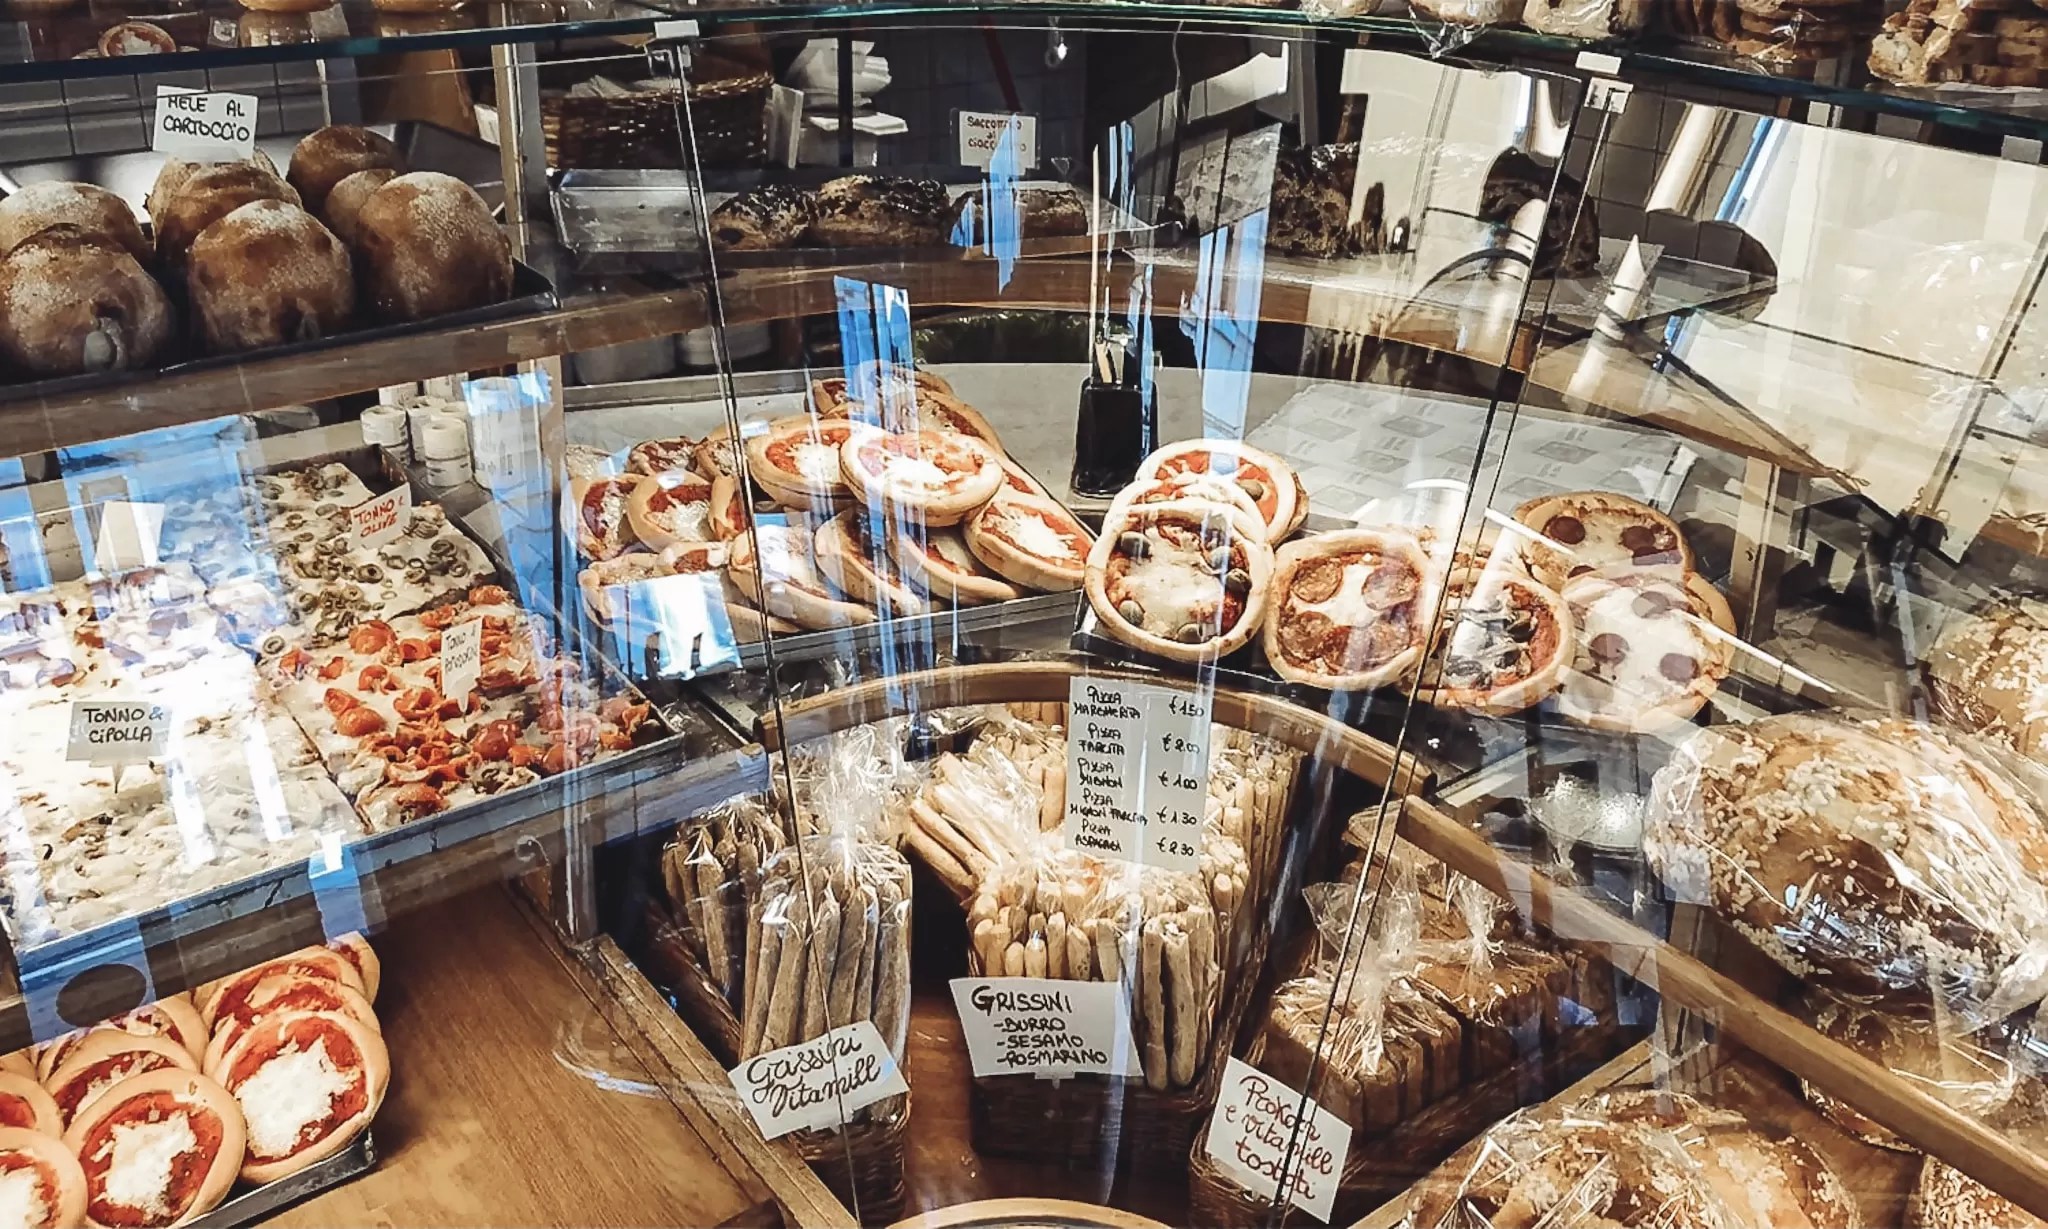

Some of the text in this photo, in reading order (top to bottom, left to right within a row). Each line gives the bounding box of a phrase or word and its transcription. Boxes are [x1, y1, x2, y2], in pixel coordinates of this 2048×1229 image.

[226, 100, 245, 116] AL
[354, 499, 395, 524] TONNO
[82, 706, 164, 723] TONNO &
[1168, 695, 1178, 715] €
[1087, 722, 1121, 739] PIZZA
[1161, 733, 1172, 752] €
[1158, 771, 1168, 787] €
[1083, 787, 1113, 806] PIZZA
[1156, 806, 1168, 823] €
[1156, 837, 1167, 853] €
[971, 985, 1073, 1016] GRISSINI
[746, 1027, 863, 1104] Grissini
[769, 1053, 881, 1119] Vitamill
